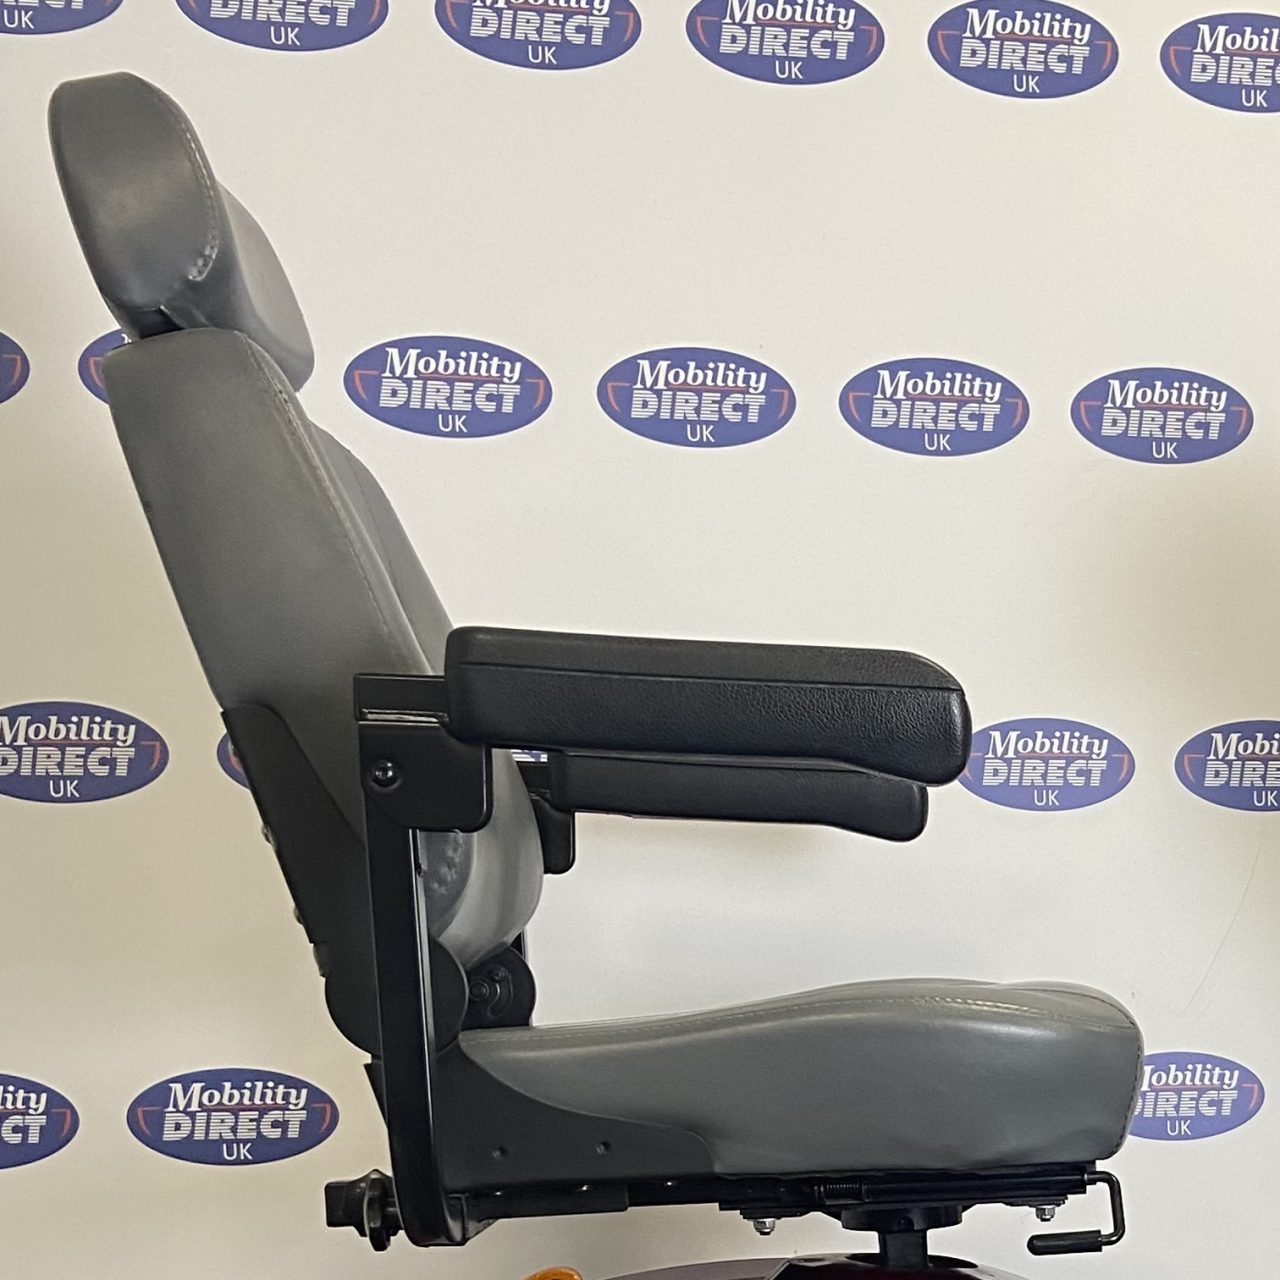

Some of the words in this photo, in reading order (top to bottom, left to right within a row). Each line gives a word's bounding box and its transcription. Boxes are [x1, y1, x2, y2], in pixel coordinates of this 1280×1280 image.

[4, 10, 34, 28] UK
[470, 8, 610, 45] DIRECT
[720, 0, 855, 30] Mobility
[962, 8, 1091, 44] Mobility
[270, 26, 300, 46] UK
[719, 25, 854, 59] DIRECT
[528, 45, 557, 64] UK
[960, 39, 1090, 74] DIRECT
[776, 61, 802, 79] UK
[1014, 75, 1039, 92] UK
[1242, 89, 1267, 107] UK
[382, 348, 521, 383] Mobility
[633, 360, 766, 393] Mobility
[380, 379, 520, 412] DIRECT
[874, 370, 1001, 404] Mobility
[1104, 380, 1227, 411] Mobility
[631, 390, 765, 422] DIRECT
[871, 400, 1000, 432] DIRECT
[439, 414, 467, 432] UK
[687, 425, 714, 442] UK
[1102, 409, 1225, 439] DIRECT
[925, 433, 951, 450] UK
[1153, 442, 1177, 458] UK
[0, 716, 135, 746] Mobility
[985, 731, 1108, 759] Mobility
[0, 747, 135, 776] DIRECT
[983, 760, 1107, 786] DIRECT
[50, 780, 79, 797] UK
[1035, 790, 1059, 805] UK
[1253, 790, 1278, 806] UK
[165, 1082, 307, 1111] Mobility
[1134, 1091, 1237, 1117] IRECT
[163, 1111, 306, 1140] DIRECT
[1168, 1120, 1191, 1135] UK
[223, 1143, 252, 1160] UK
